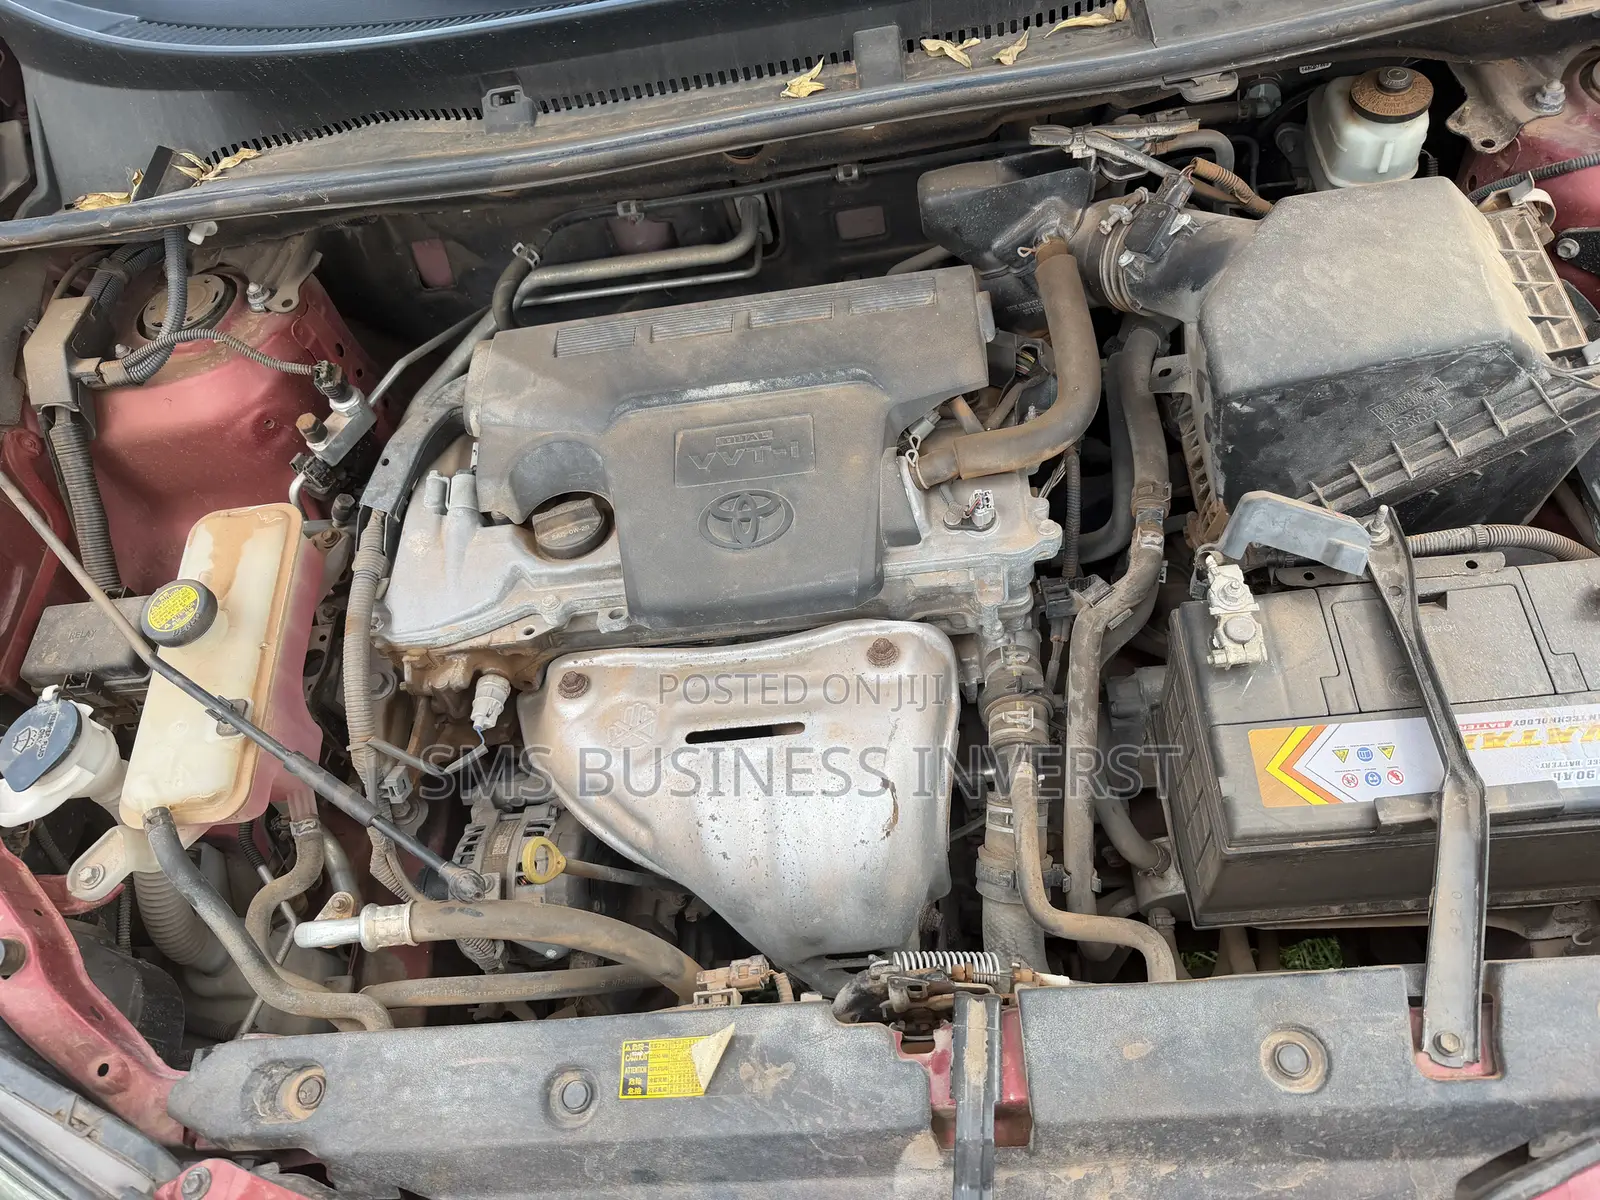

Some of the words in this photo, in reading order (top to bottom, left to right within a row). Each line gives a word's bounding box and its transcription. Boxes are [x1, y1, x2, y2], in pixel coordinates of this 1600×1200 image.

[715, 430, 774, 447] DUAL
[68, 629, 98, 640] RELAY
[1458, 721, 1506, 731] BATTER
